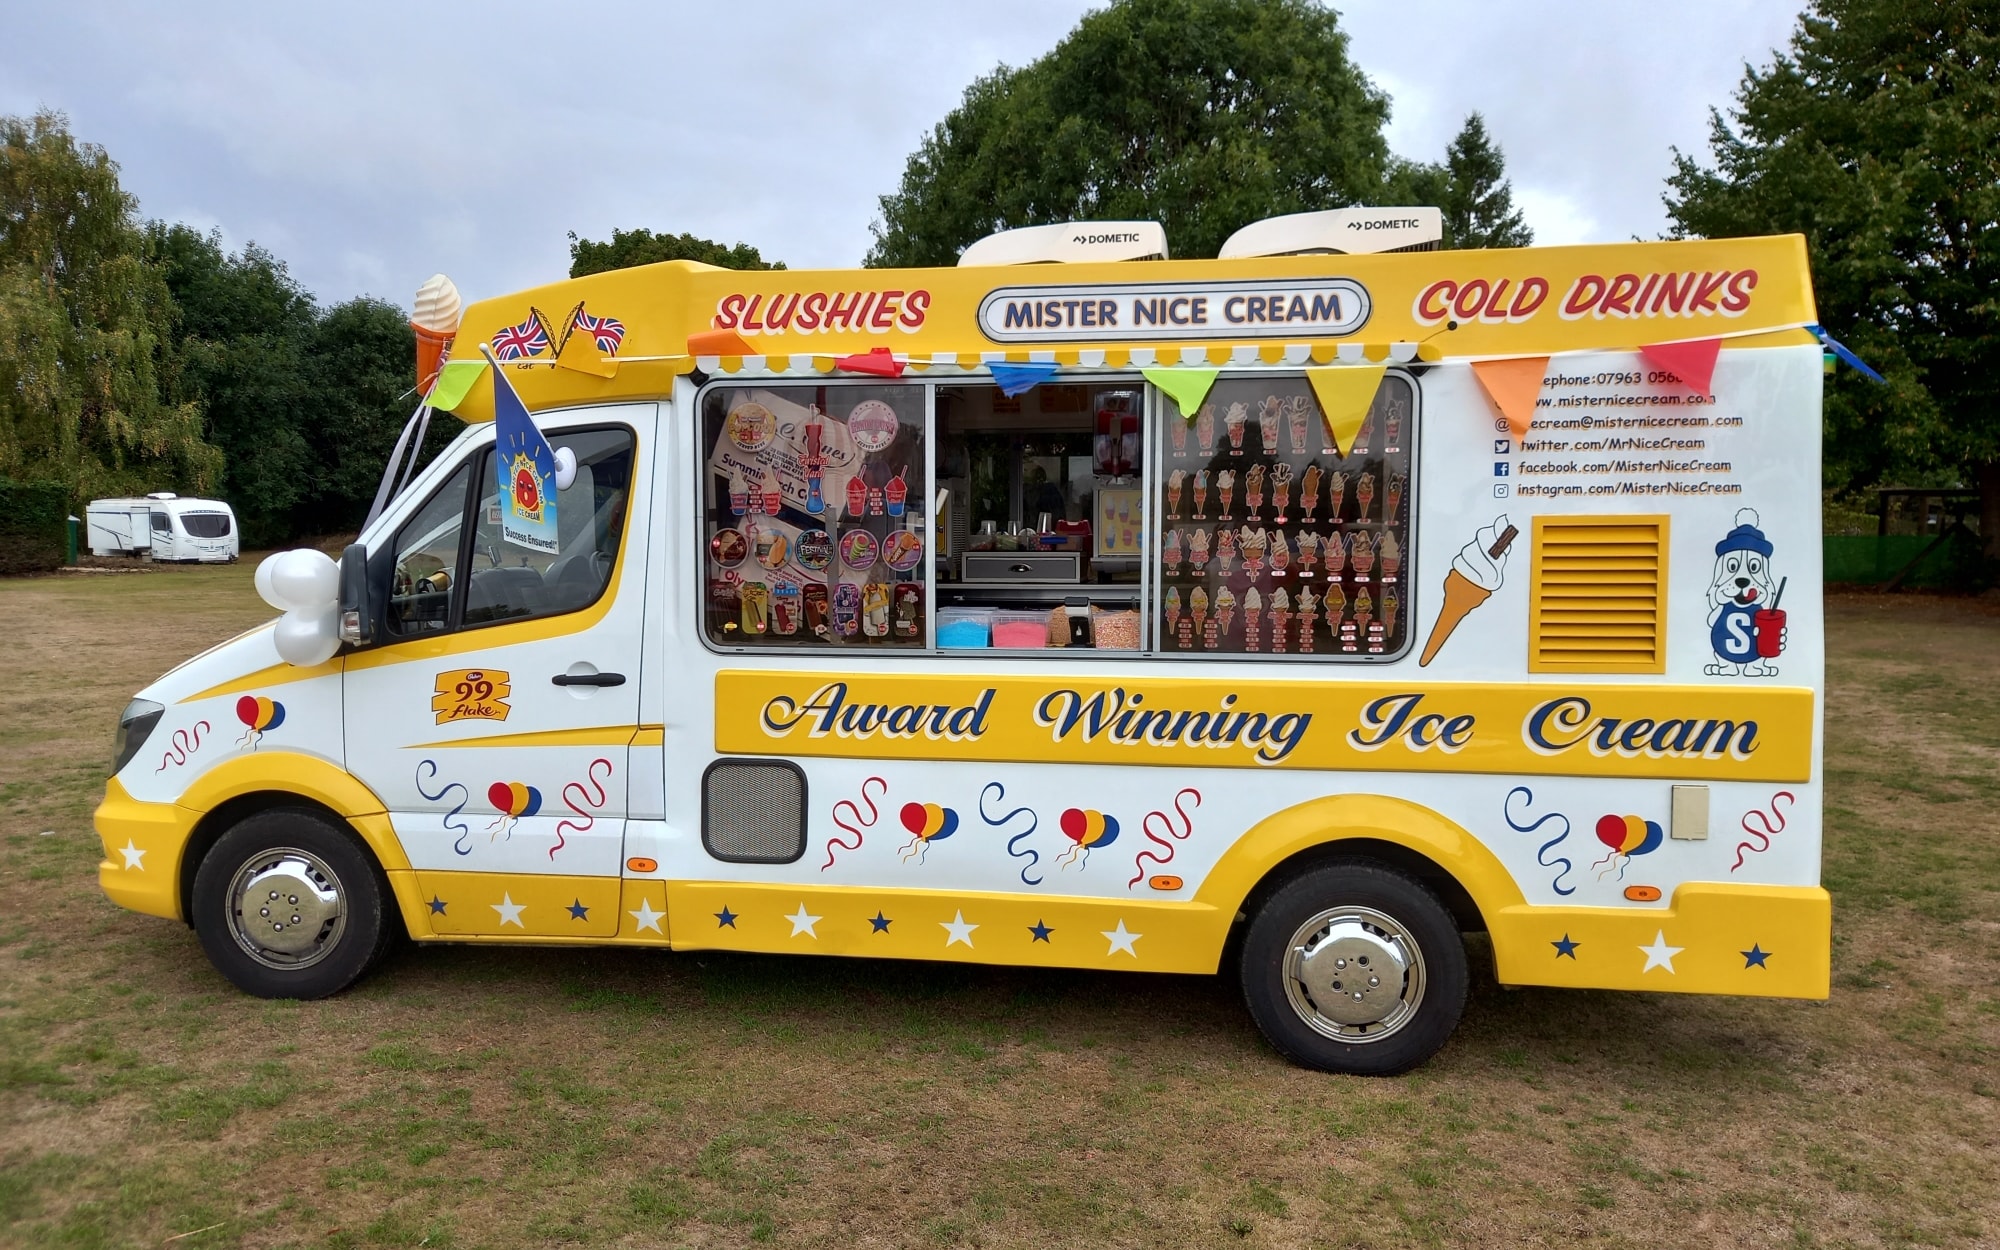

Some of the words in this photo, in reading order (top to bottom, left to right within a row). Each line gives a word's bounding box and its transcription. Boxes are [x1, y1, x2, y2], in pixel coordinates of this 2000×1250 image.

[1364, 219, 1420, 231] DOMETIC
[1088, 233, 1140, 244] DOMETIC
[1412, 277, 1549, 326] COLD
[1558, 269, 1758, 320] DRINKS
[714, 289, 931, 336] SLUSHIES
[1004, 300, 1118, 328] MISTER
[1133, 298, 1208, 326] NICE
[1224, 295, 1343, 324] CREAM
[1543, 373, 1642, 388] ephone:07963
[1521, 437, 1706, 451] twitter.com/MrNiceCream
[1519, 459, 1732, 474] facebook.com/MisterNiceCream
[1517, 481, 1742, 497] instagram.com/MisterNiceCream
[1725, 612, 1750, 655] S
[455, 681, 493, 702] 99
[448, 702, 500, 718] flake
[759, 682, 997, 741] Award
[1032, 688, 1312, 765] Winning
[1346, 694, 1476, 754] Ice
[1521, 697, 1760, 762] Cream
